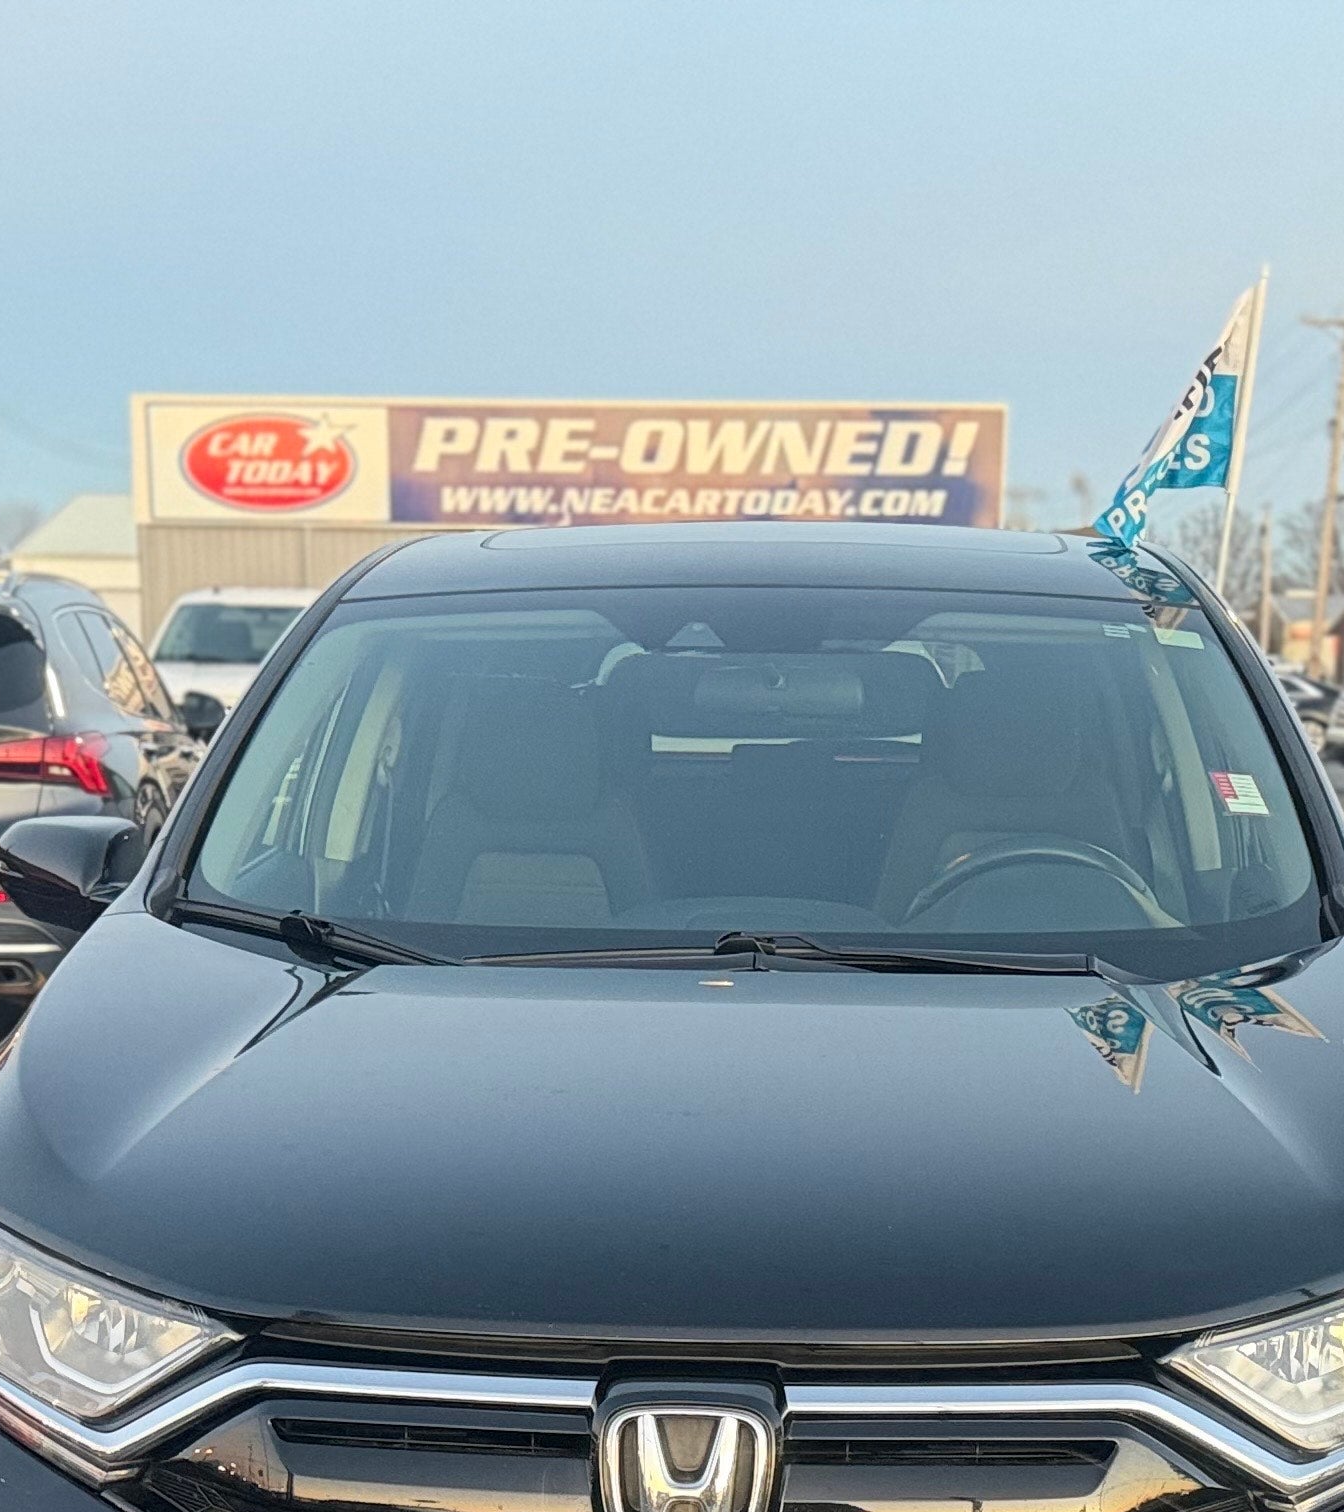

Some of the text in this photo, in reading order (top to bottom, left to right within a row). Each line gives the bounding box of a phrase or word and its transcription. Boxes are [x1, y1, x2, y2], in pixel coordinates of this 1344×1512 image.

[207, 431, 278, 457] CAR
[412, 417, 980, 477] PRE-OWNED!
[225, 459, 340, 486] TODAY
[439, 486, 948, 518] WWW.NEACARTODAY.COM
